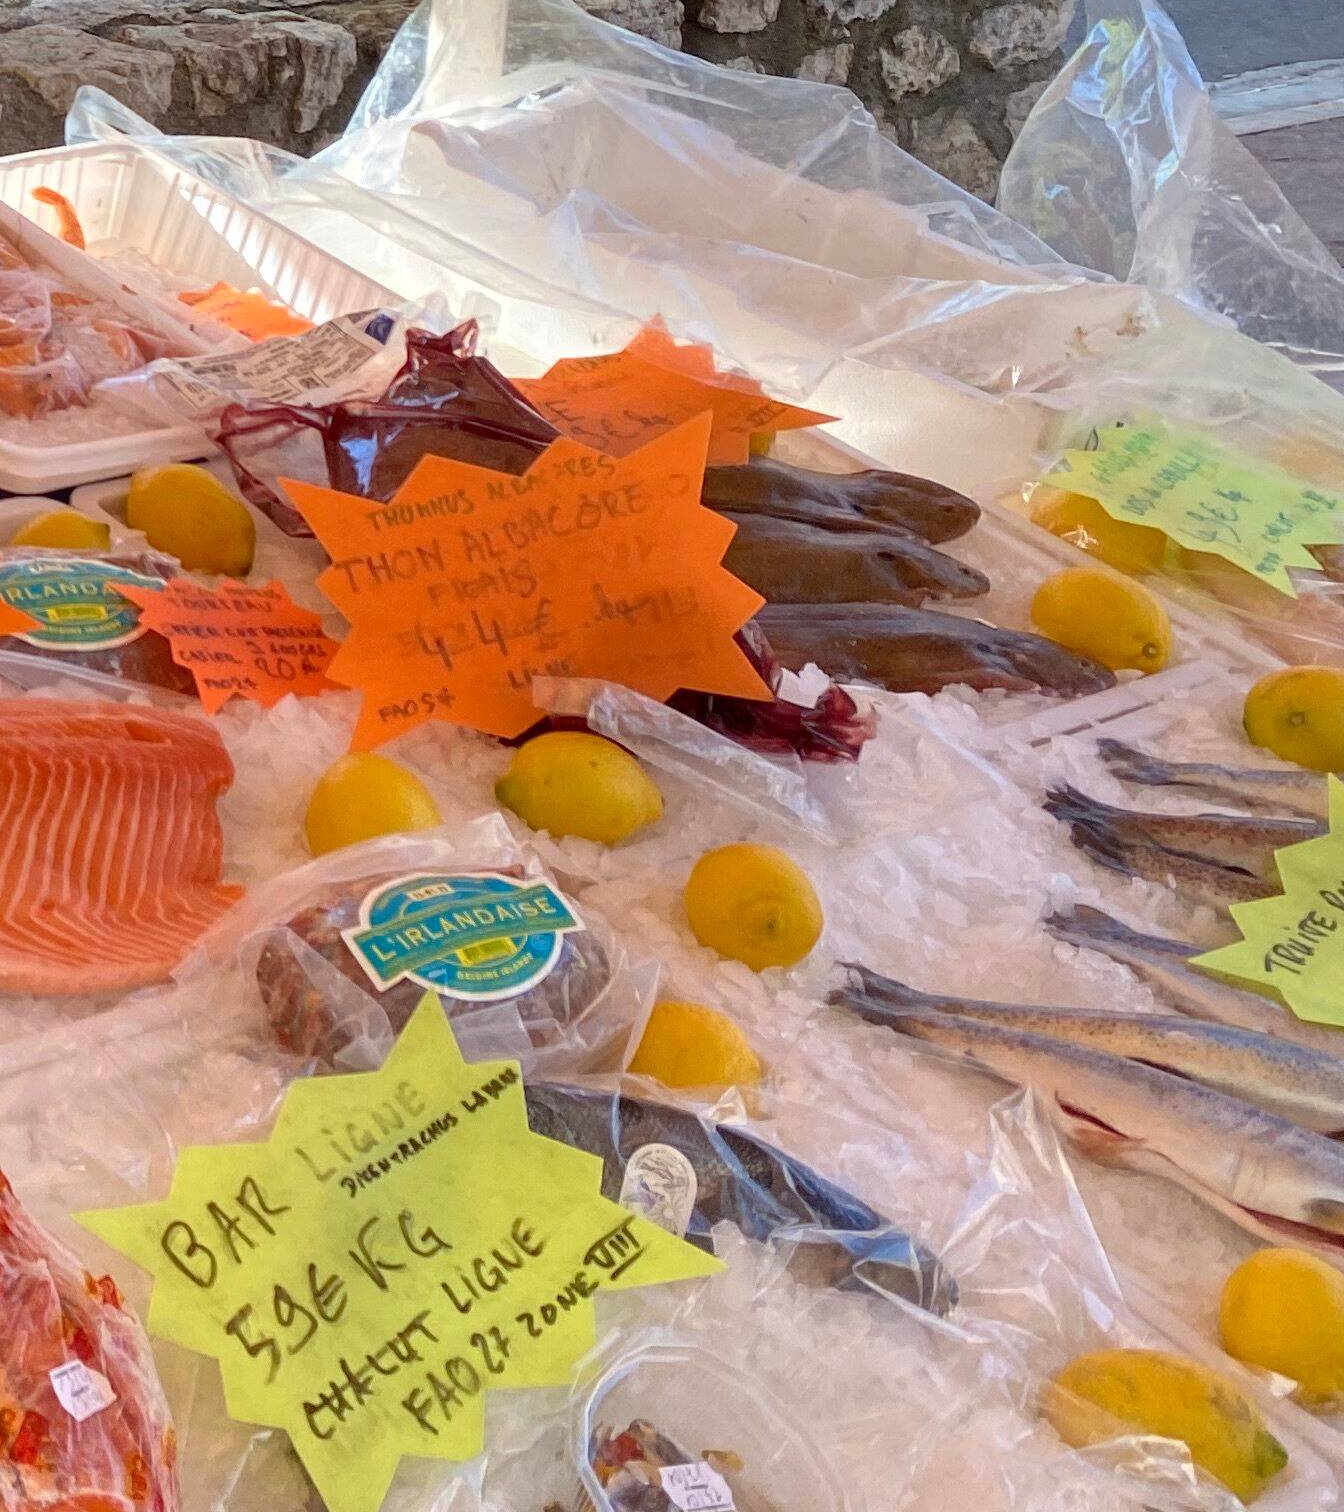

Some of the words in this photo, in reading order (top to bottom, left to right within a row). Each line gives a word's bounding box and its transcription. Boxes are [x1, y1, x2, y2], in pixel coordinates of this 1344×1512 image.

[335, 536, 447, 595] THON
[463, 487, 647, 565] ALBACORE
[370, 896, 559, 963] L'IRLANDAISE
[159, 1172, 293, 1290] BAR
[295, 1080, 427, 1185] LIGNE
[224, 1259, 348, 1384] 59€
[348, 1208, 455, 1293] KG
[448, 1213, 549, 1314] LIGNE
[400, 1356, 482, 1438] FAO
[516, 1270, 602, 1341] ZONE
